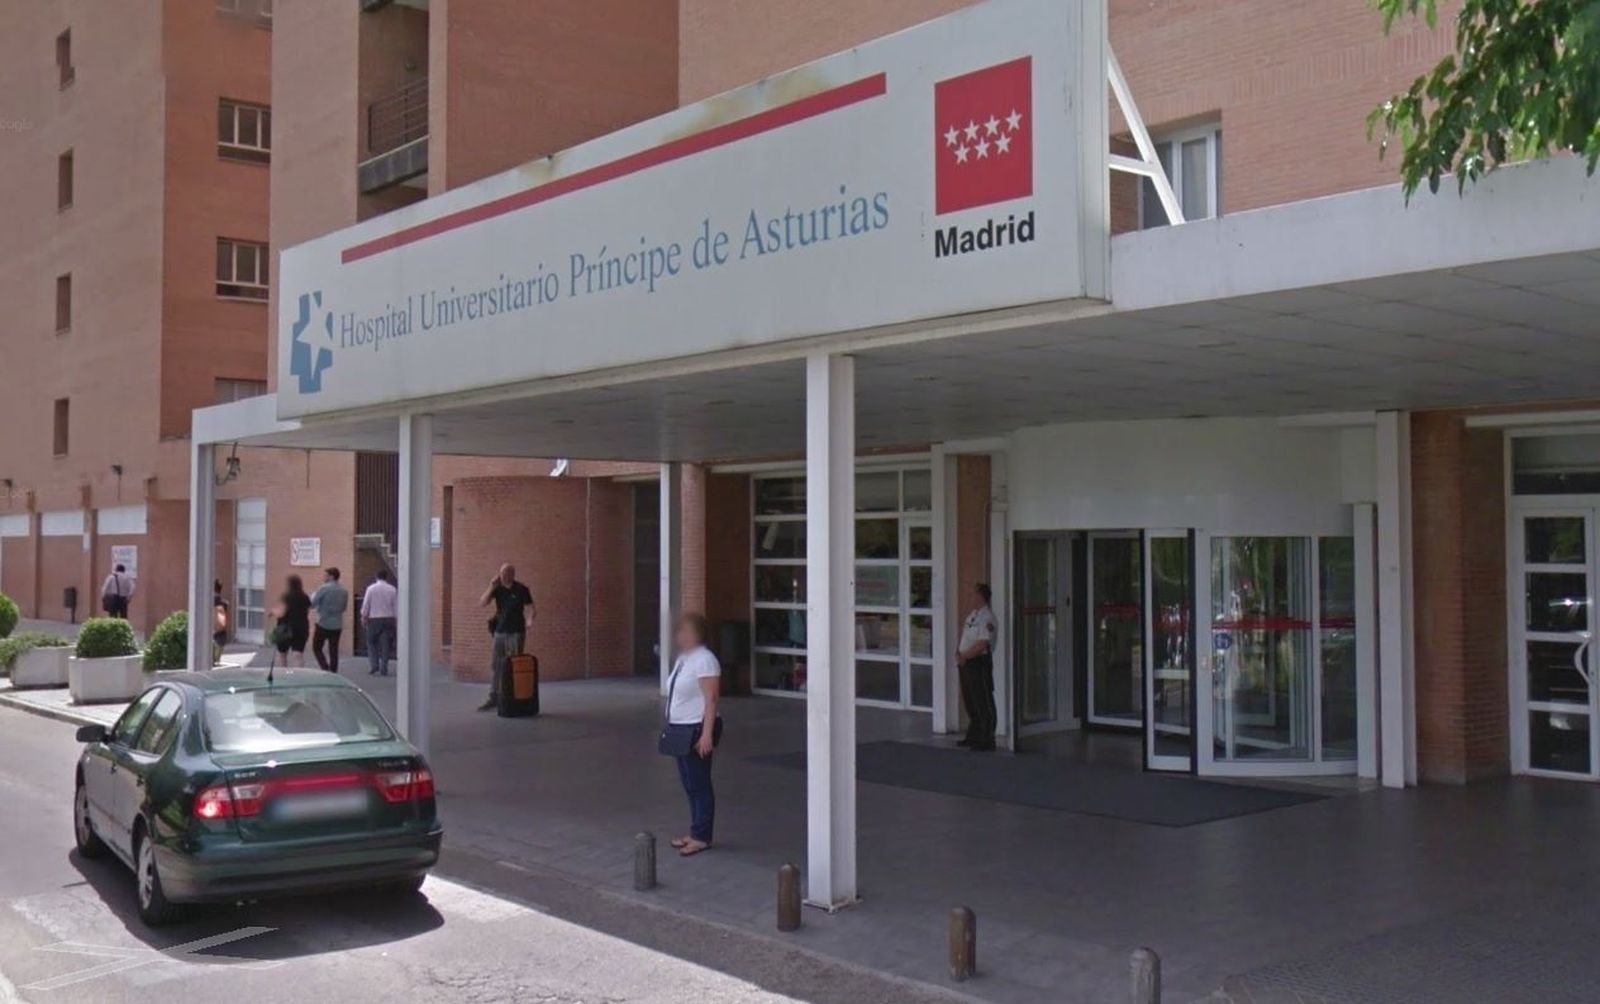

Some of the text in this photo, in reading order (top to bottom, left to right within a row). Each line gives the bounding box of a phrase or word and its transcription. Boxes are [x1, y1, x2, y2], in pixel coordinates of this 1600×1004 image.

[340, 184, 890, 352] Hospital Universitario Príncipe de Asturias
[934, 210, 1036, 258] Madrid
